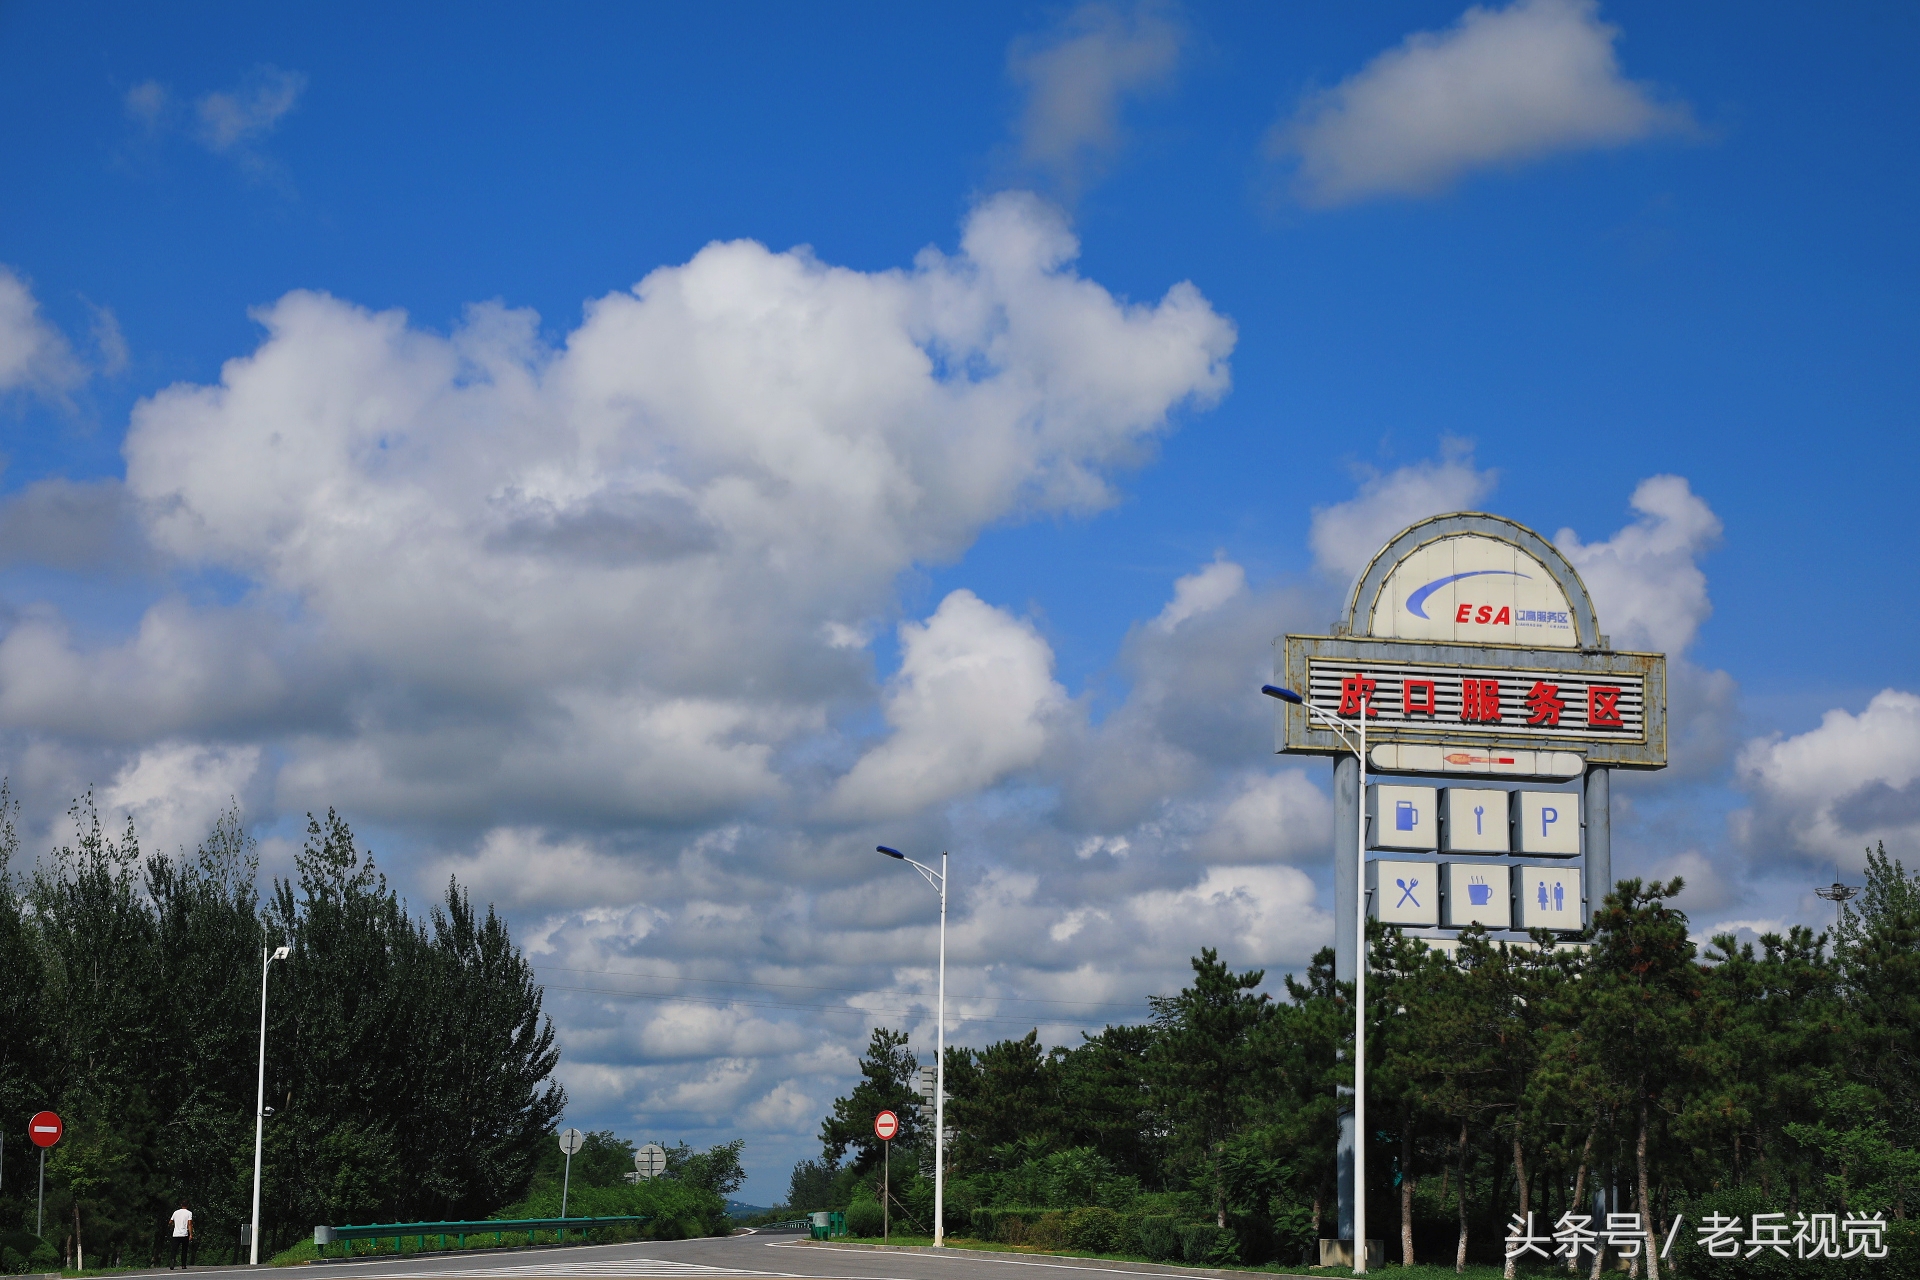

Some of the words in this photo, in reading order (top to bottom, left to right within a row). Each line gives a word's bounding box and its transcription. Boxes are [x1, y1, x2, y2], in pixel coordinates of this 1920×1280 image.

[1455, 603, 1510, 626] ESA
[1337, 673, 1624, 727] 皮口服务区
[1541, 807, 1558, 838] P
